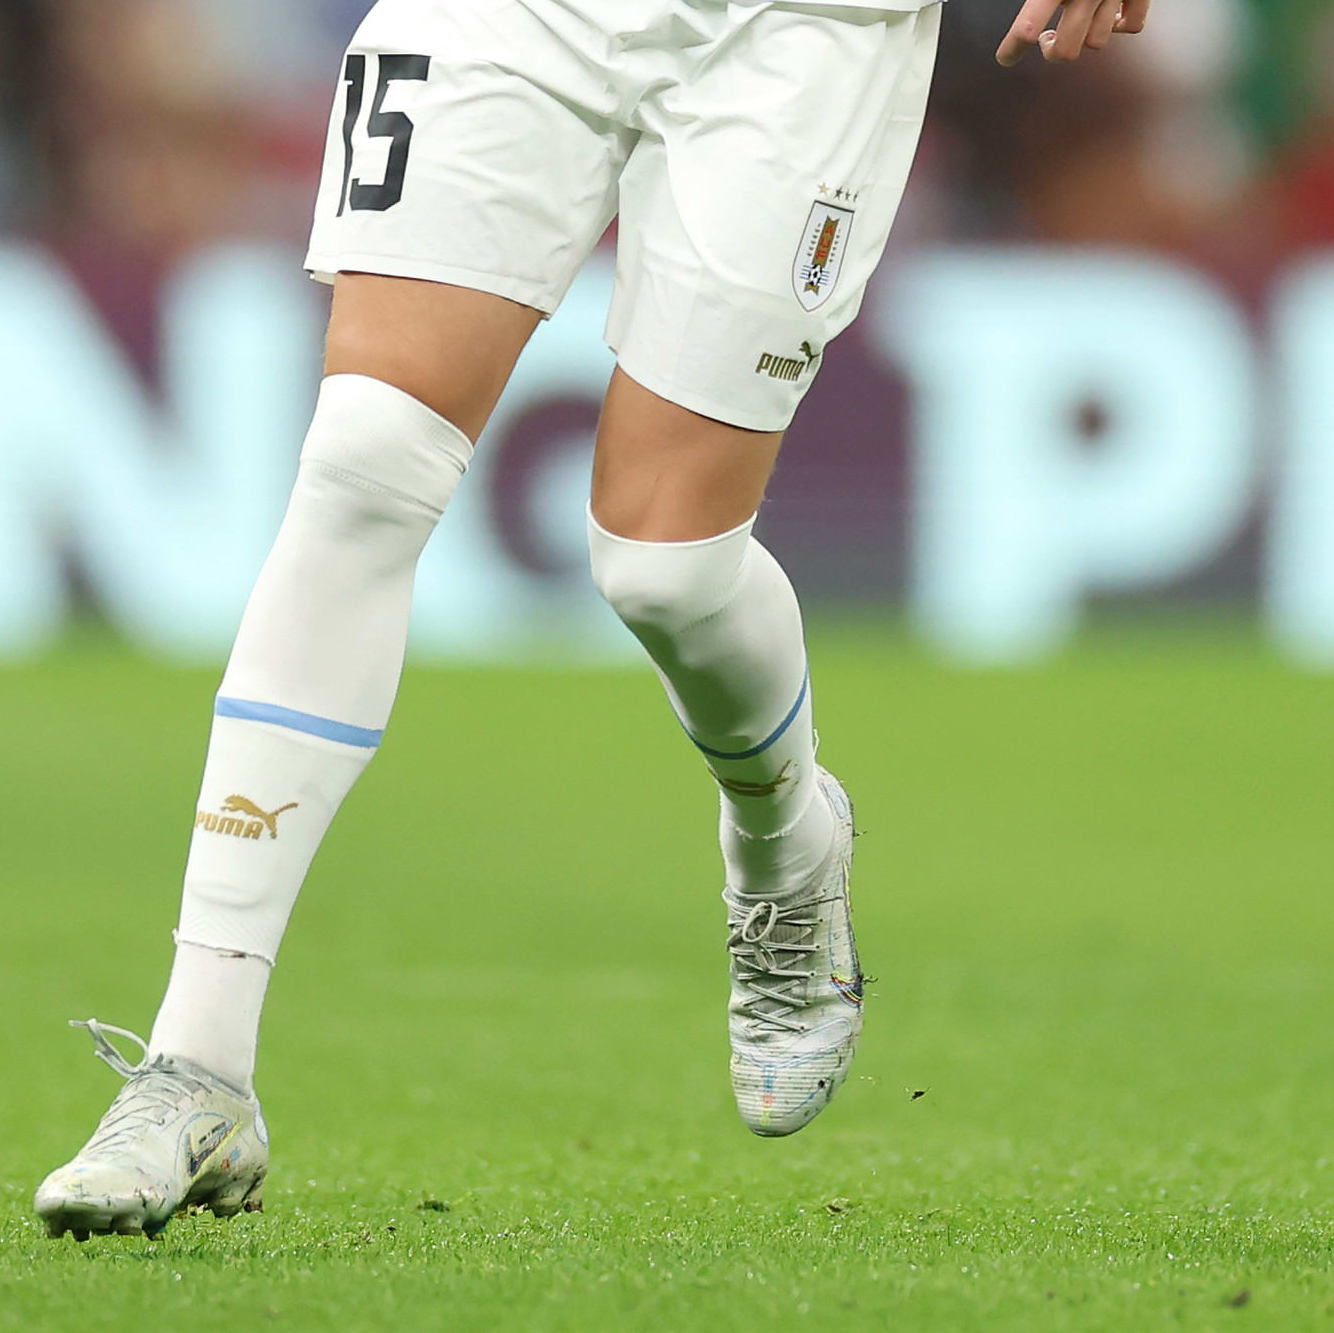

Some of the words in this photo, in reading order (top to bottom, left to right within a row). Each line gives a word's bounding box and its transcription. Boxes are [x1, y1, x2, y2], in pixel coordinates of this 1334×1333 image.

[336, 53, 431, 218] 15
[755, 352, 806, 382] PUMA
[195, 810, 264, 841] PUMA
